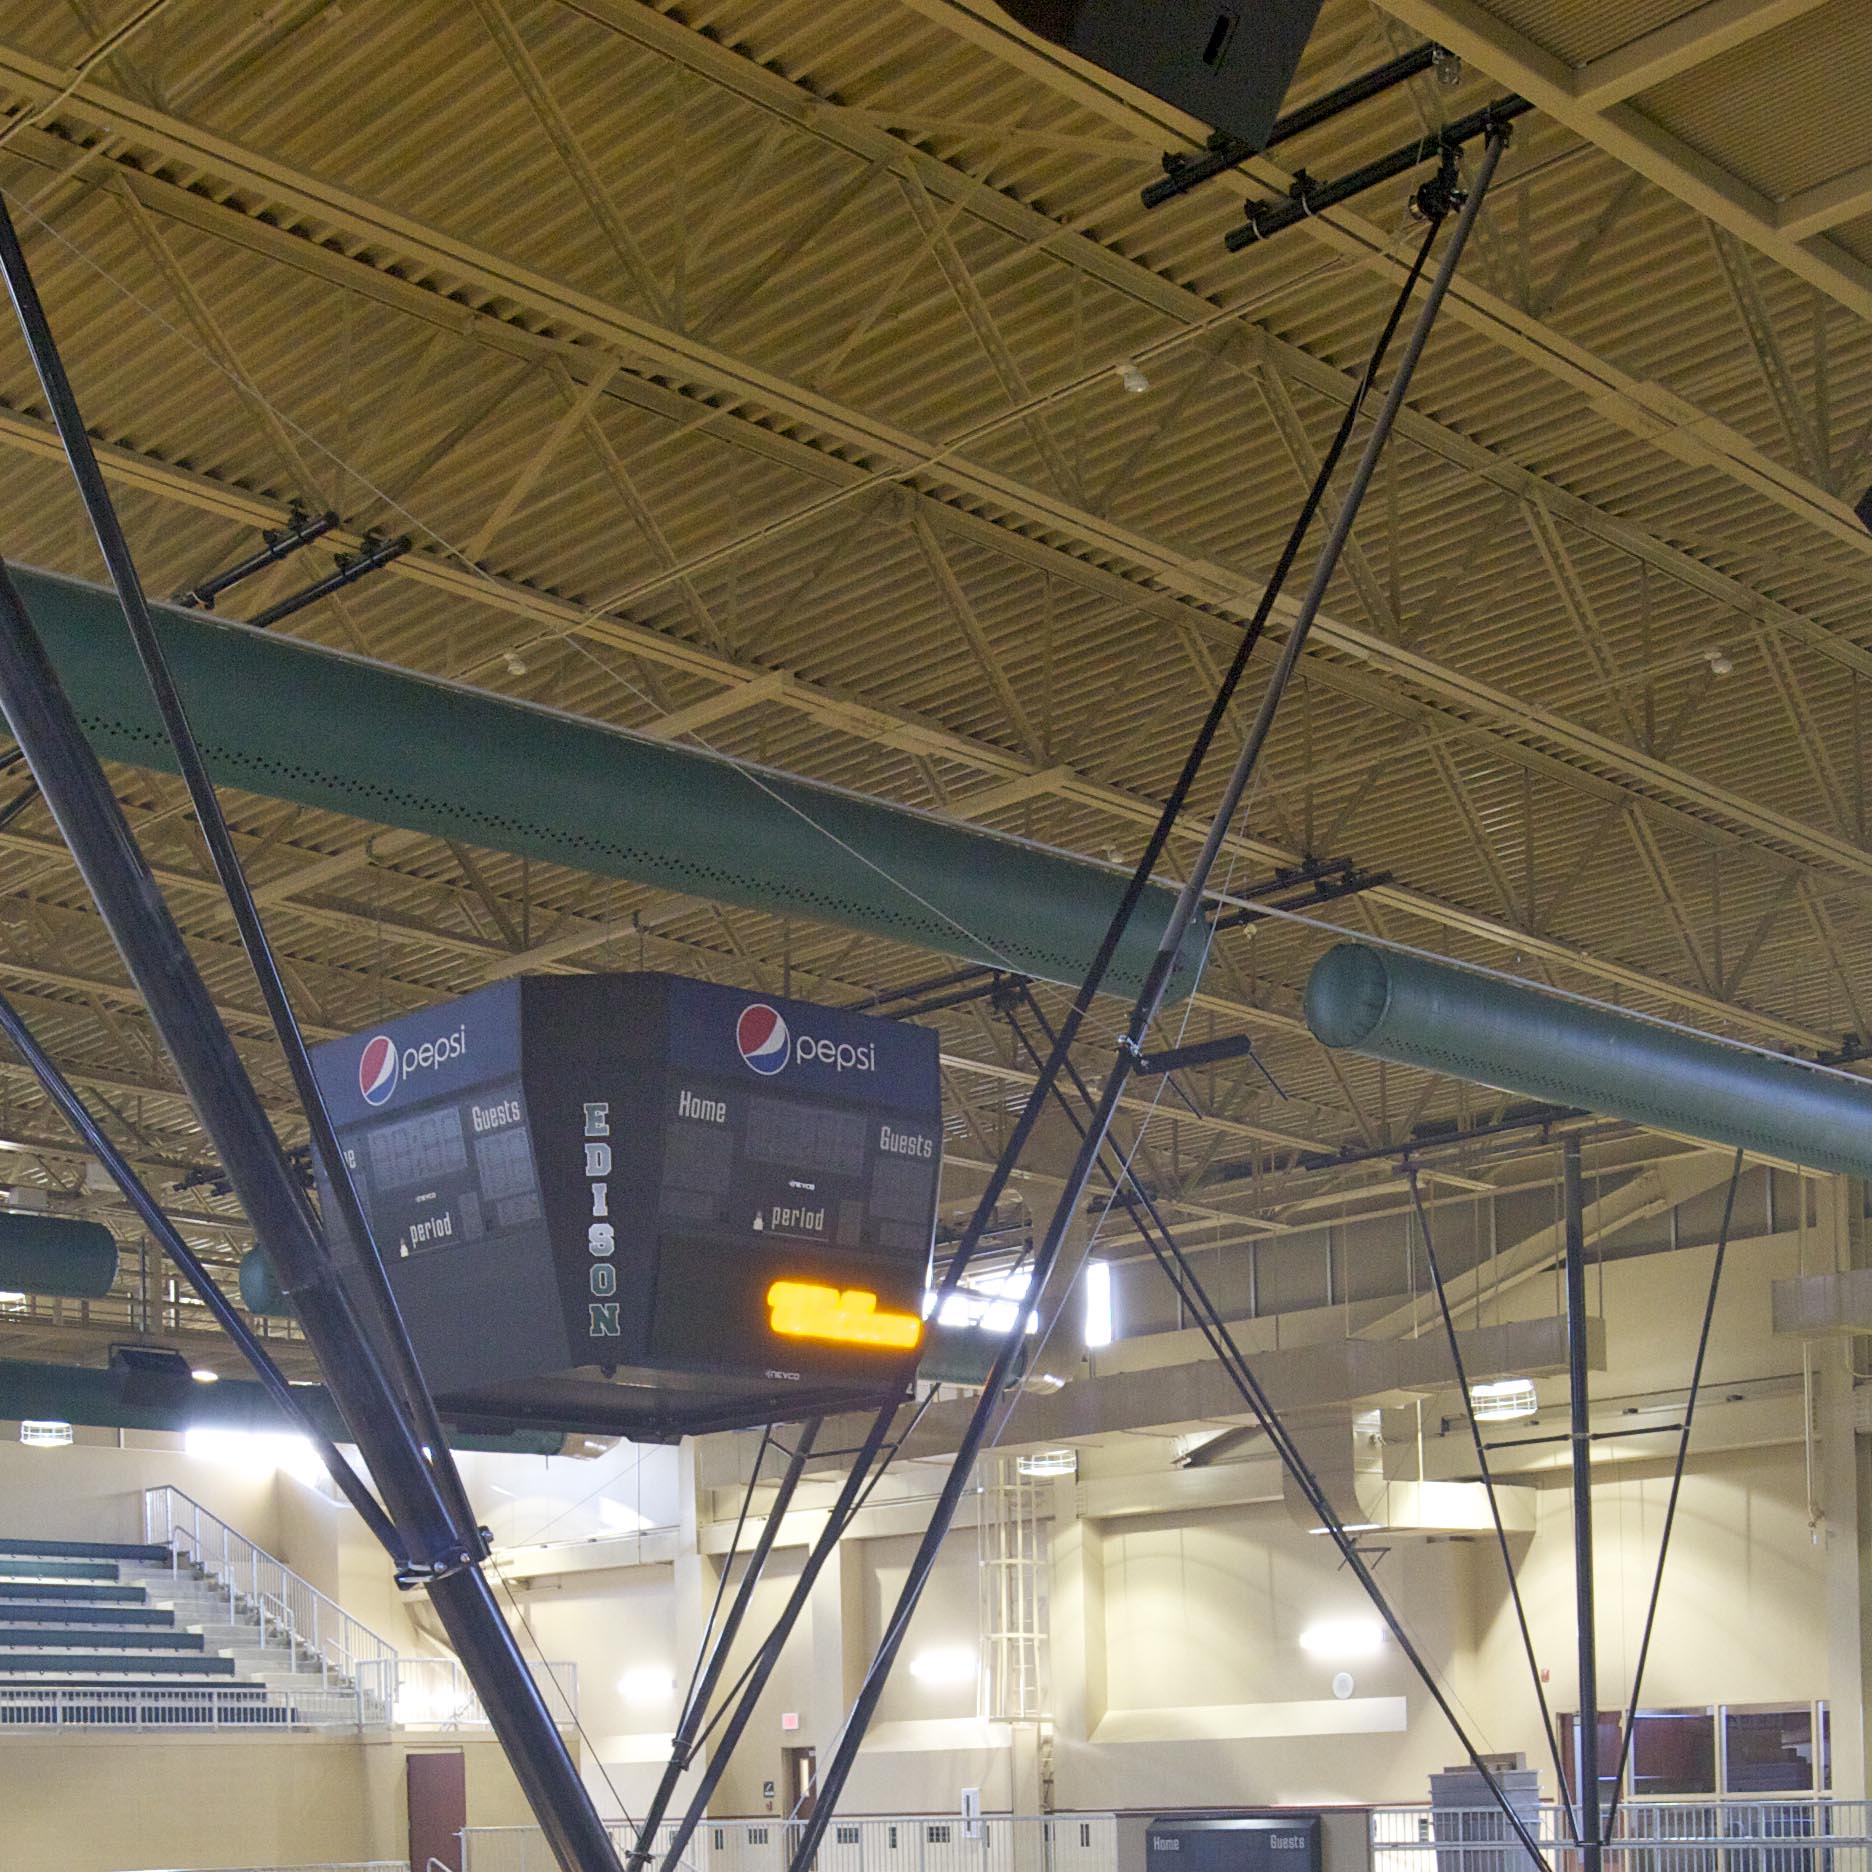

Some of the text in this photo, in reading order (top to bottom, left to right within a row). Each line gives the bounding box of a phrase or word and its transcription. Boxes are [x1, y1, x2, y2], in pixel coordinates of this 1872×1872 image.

[402, 1024, 466, 1080] pepsi
[795, 1035, 876, 1072] pepsi
[471, 1100, 521, 1132] Guests
[678, 1089, 727, 1123] Home
[879, 1126, 934, 1158] Guests
[409, 1211, 453, 1249] period
[771, 1205, 825, 1231] period
[1153, 1836, 1180, 1850] Home
[1270, 1834, 1305, 1849] Guests
